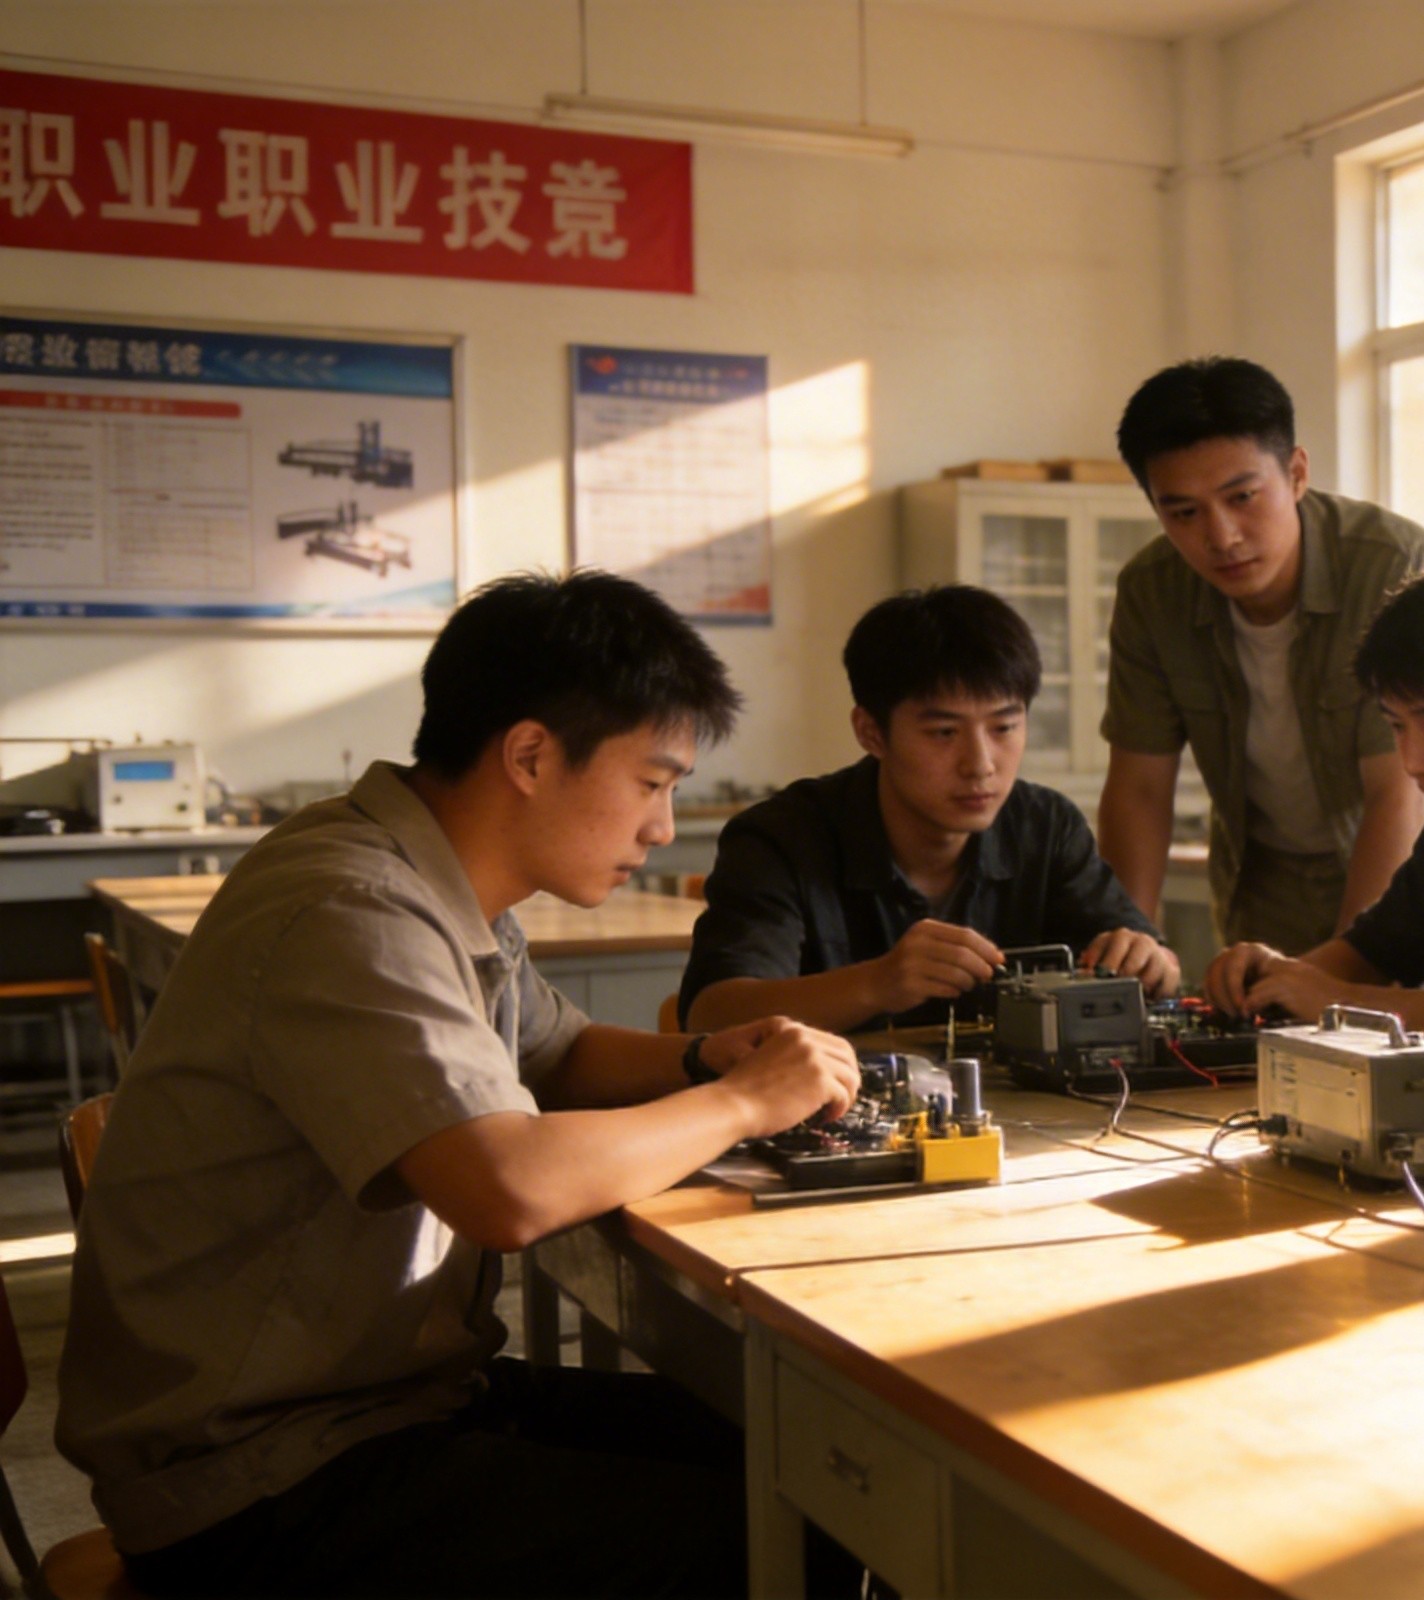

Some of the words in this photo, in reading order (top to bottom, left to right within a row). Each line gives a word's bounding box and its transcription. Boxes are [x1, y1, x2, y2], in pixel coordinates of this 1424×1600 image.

[0, 107, 628, 260] 职业职业技竞
